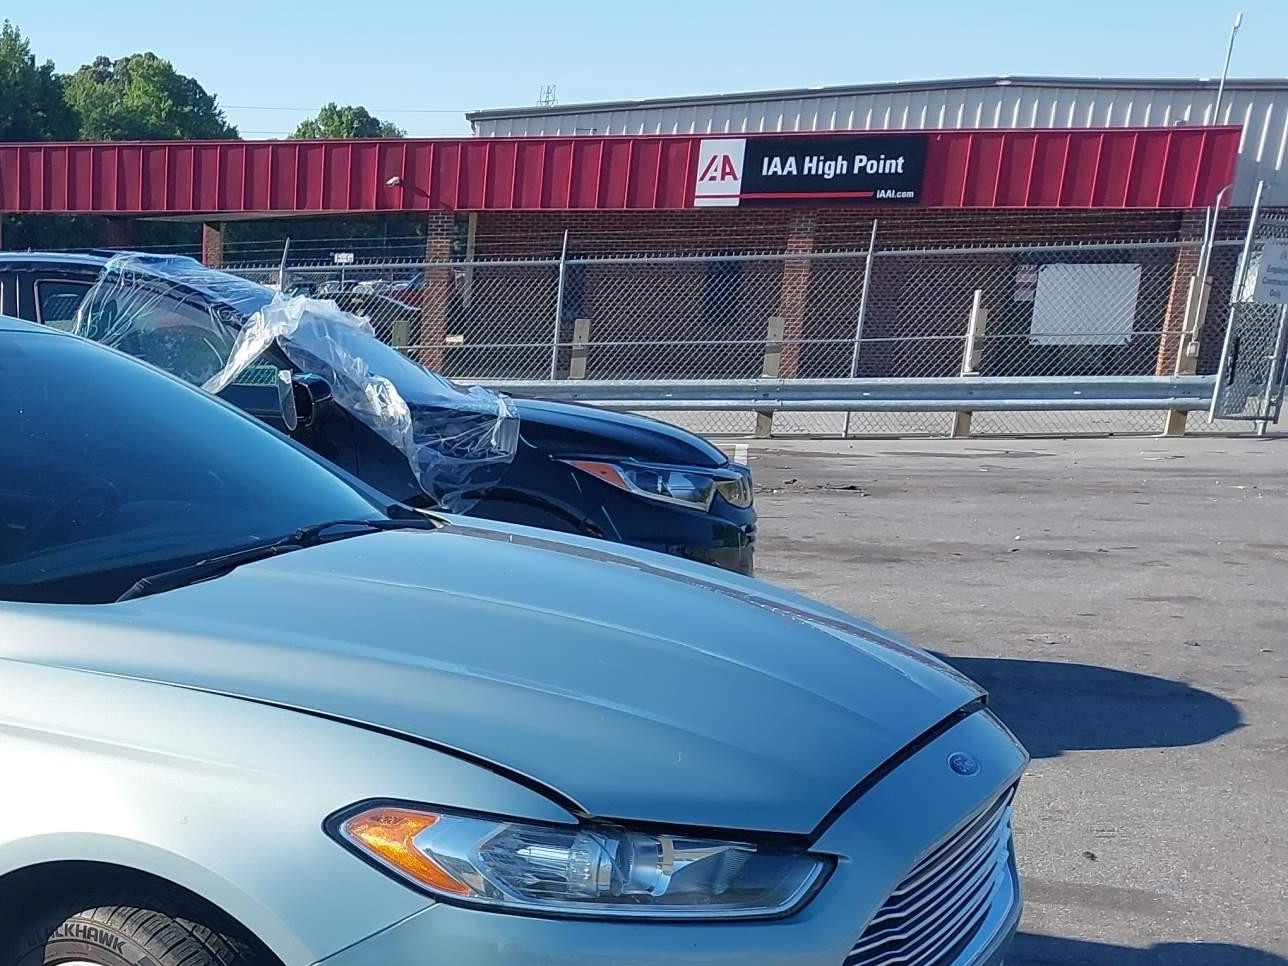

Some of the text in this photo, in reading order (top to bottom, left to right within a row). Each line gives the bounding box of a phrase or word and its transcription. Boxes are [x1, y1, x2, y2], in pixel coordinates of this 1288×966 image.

[762, 154, 905, 179] IAA High Point
[876, 189, 914, 199] IAAI.com
